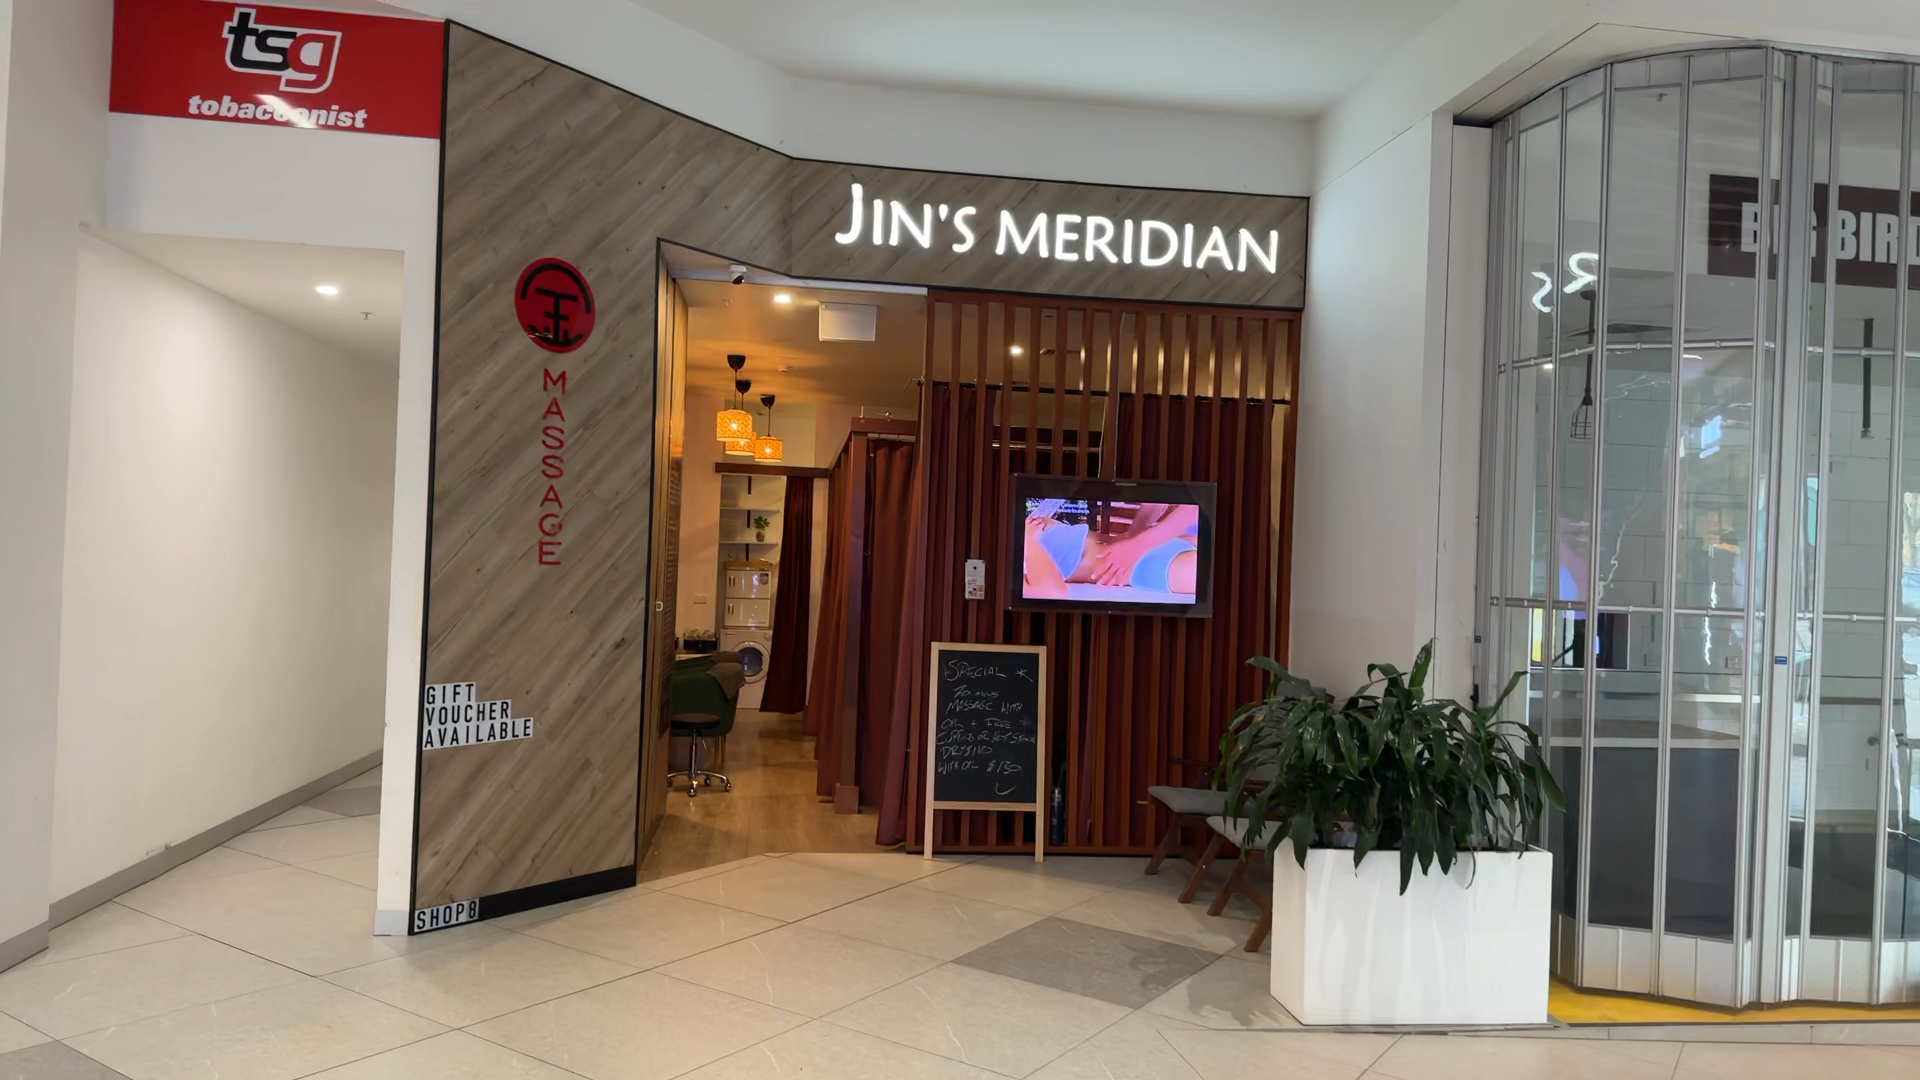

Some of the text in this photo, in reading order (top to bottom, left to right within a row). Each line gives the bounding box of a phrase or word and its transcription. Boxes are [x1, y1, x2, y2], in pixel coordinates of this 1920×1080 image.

[222, 7, 342, 93] tsg
[834, 182, 1279, 274] JIN'S MERIDIAN
[1740, 201, 1817, 258] BI
[538, 367, 567, 566] MASSAGE
[947, 659, 1007, 682] SPECIAL
[426, 683, 474, 705] GIFT
[946, 699, 1023, 715] MASSAGE WITH
[425, 701, 509, 726] VOUCHER
[940, 718, 964, 730] OIL
[984, 718, 1012, 729] FREE
[424, 718, 531, 748] AVAILABLE
